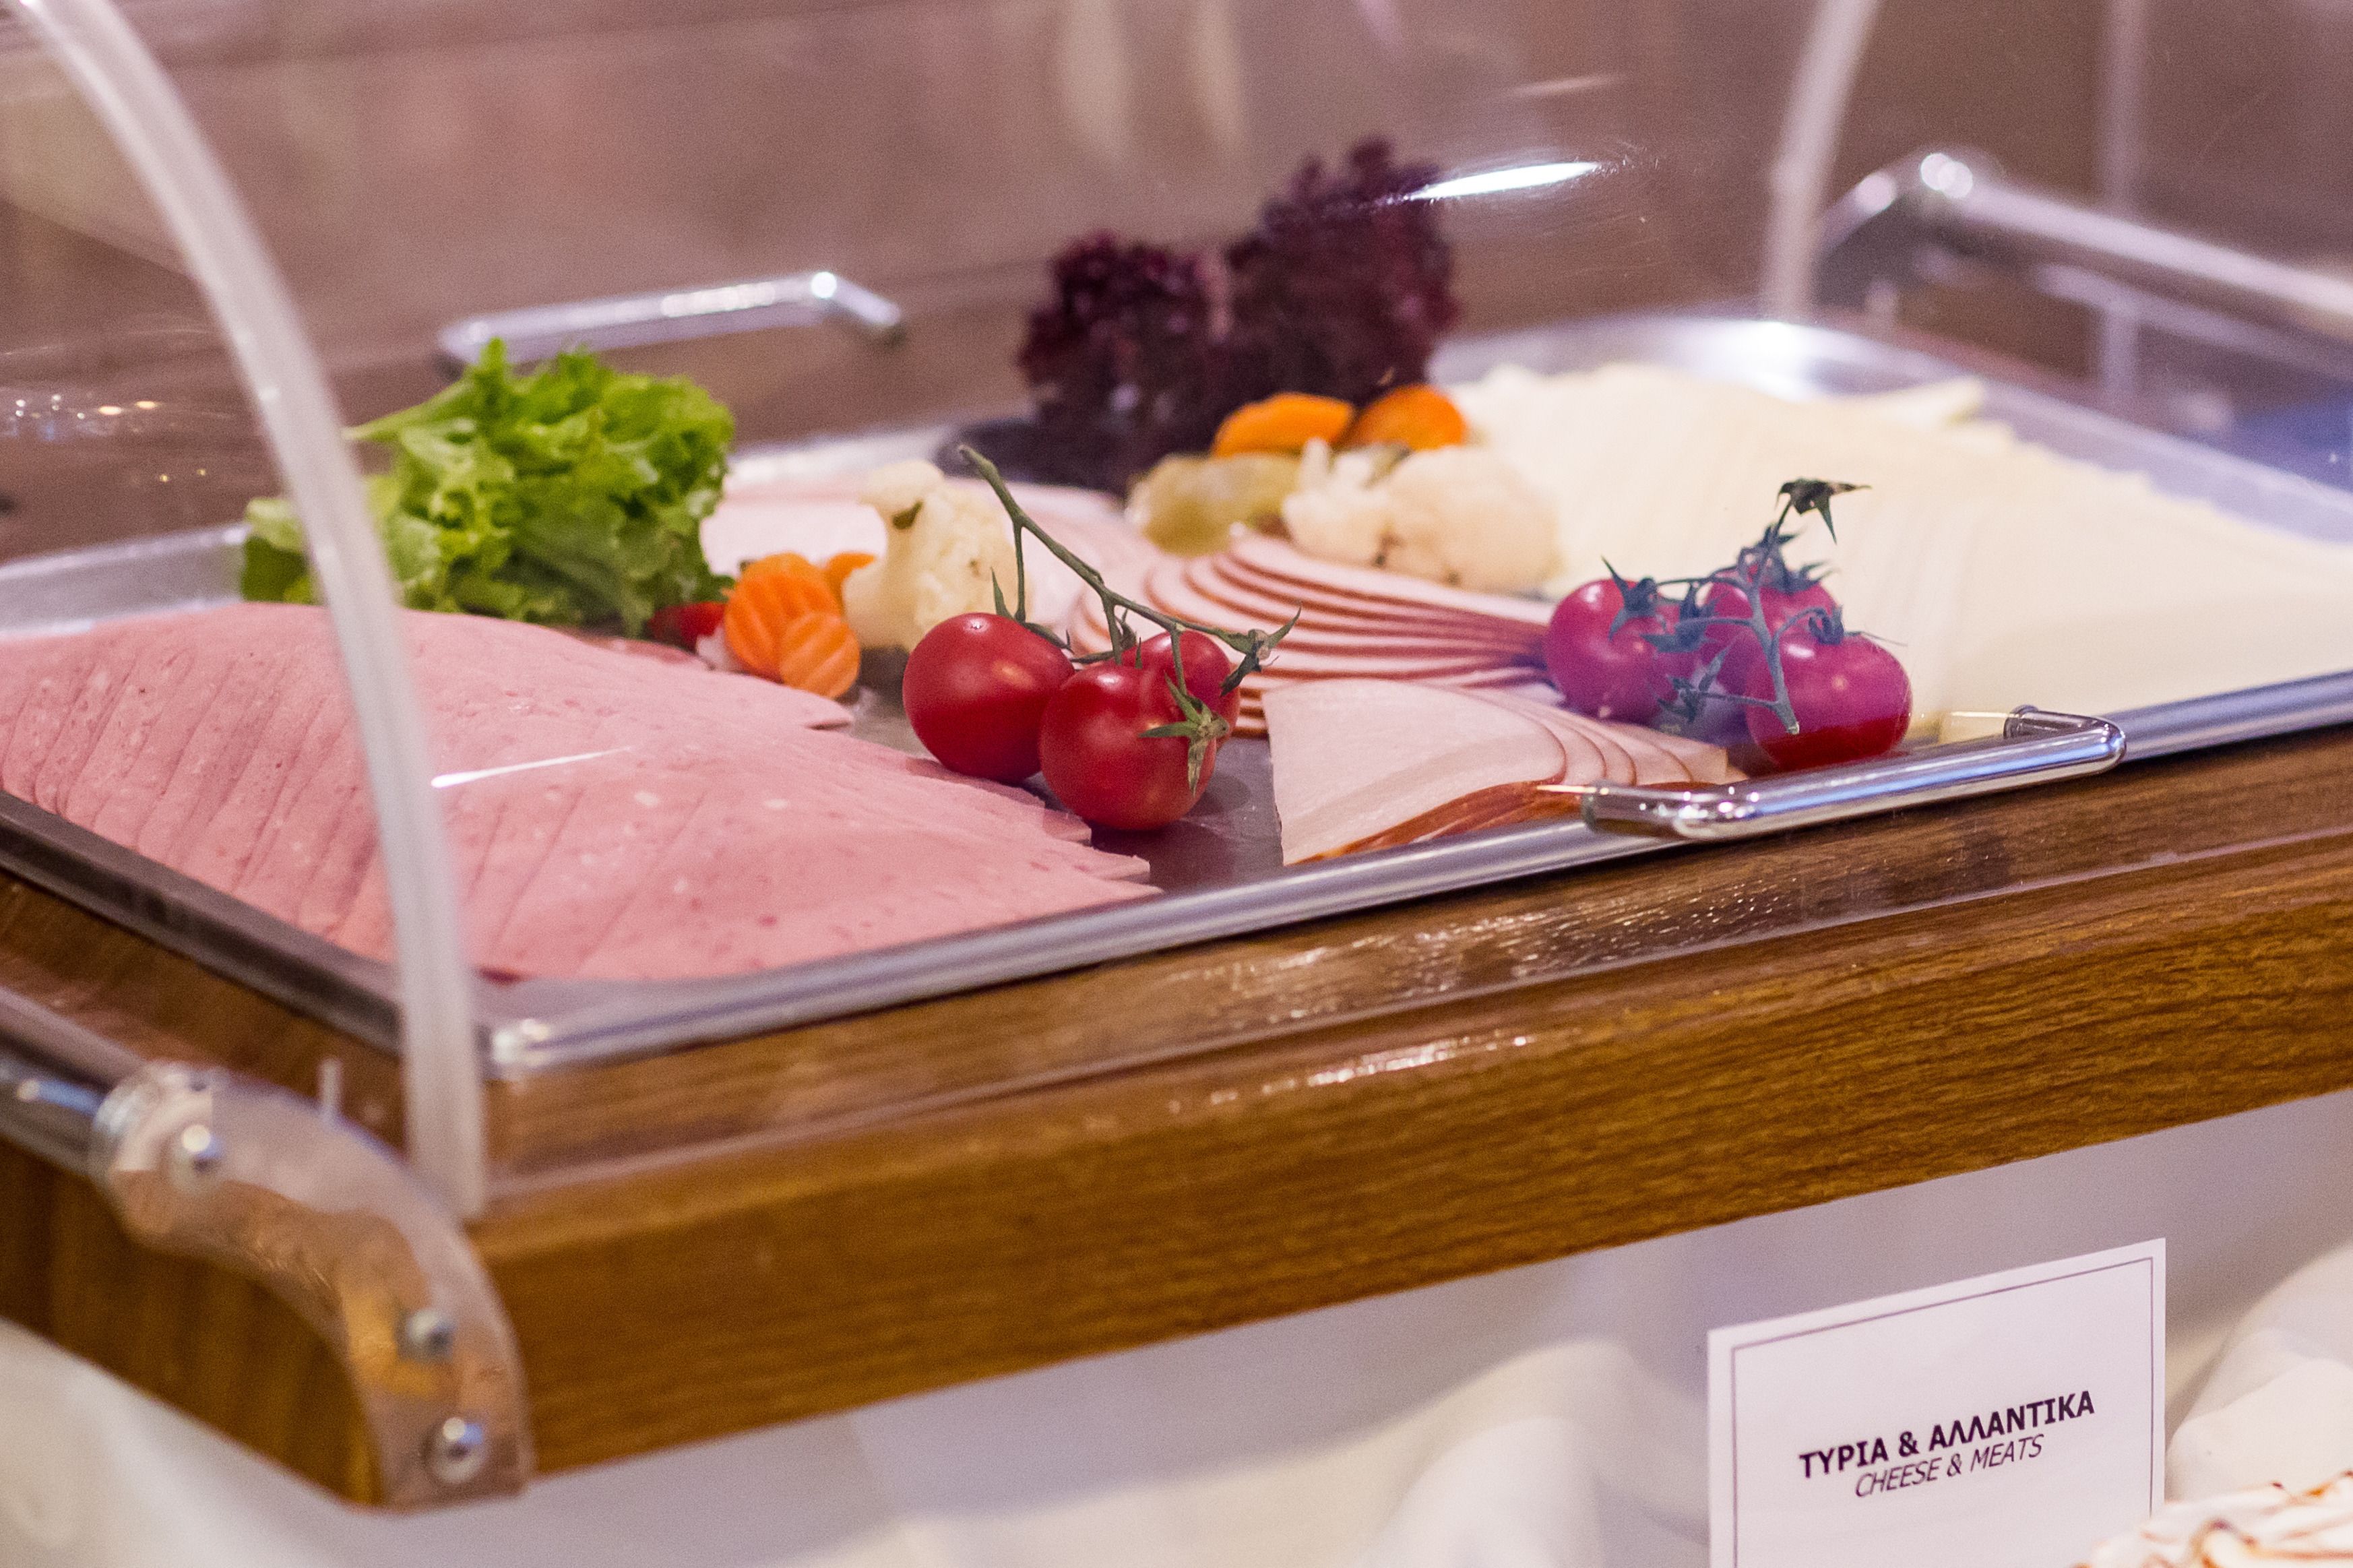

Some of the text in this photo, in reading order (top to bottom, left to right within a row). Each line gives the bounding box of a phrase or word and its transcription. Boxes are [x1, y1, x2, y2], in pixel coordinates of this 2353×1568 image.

[1799, 1390, 2095, 1478] ΤΥΡΙΑ & ΑΛΛΑΝΤΙΚΑ
[1855, 1433, 2044, 1497] CHEESE & MEATS
